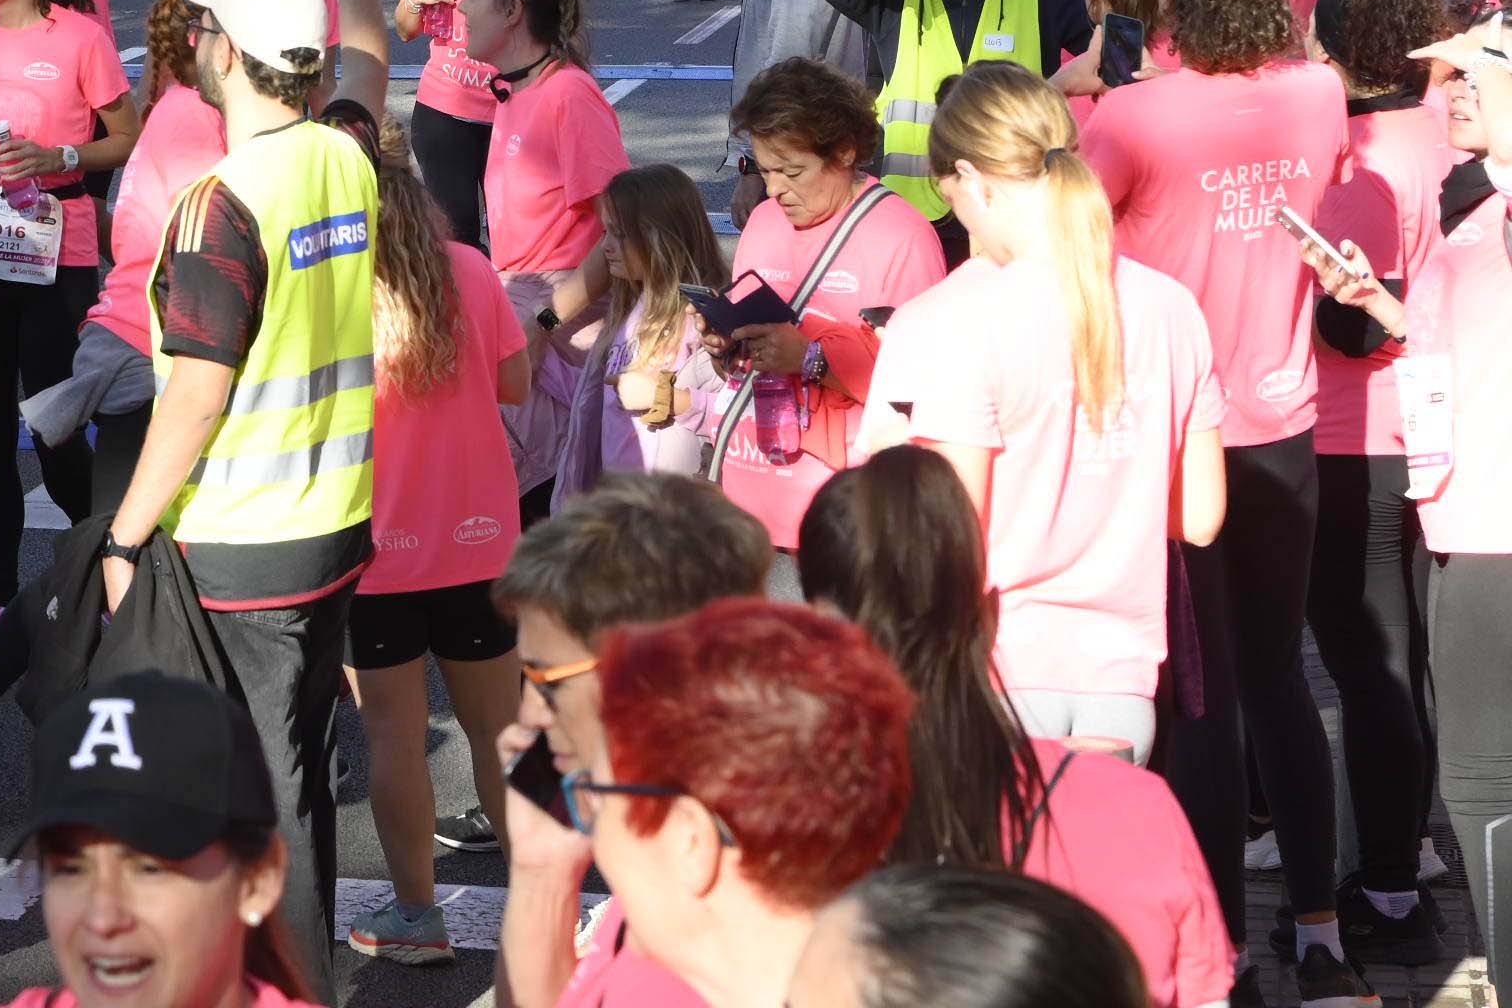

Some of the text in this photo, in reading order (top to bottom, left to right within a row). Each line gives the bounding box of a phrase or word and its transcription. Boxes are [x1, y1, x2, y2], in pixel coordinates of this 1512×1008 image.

[1200, 157, 1311, 193] CARRERA
[1222, 183, 1288, 211] DE LA
[1214, 205, 1278, 233] MUJE
[373, 535, 418, 552] YSHO
[69, 698, 143, 771] A
